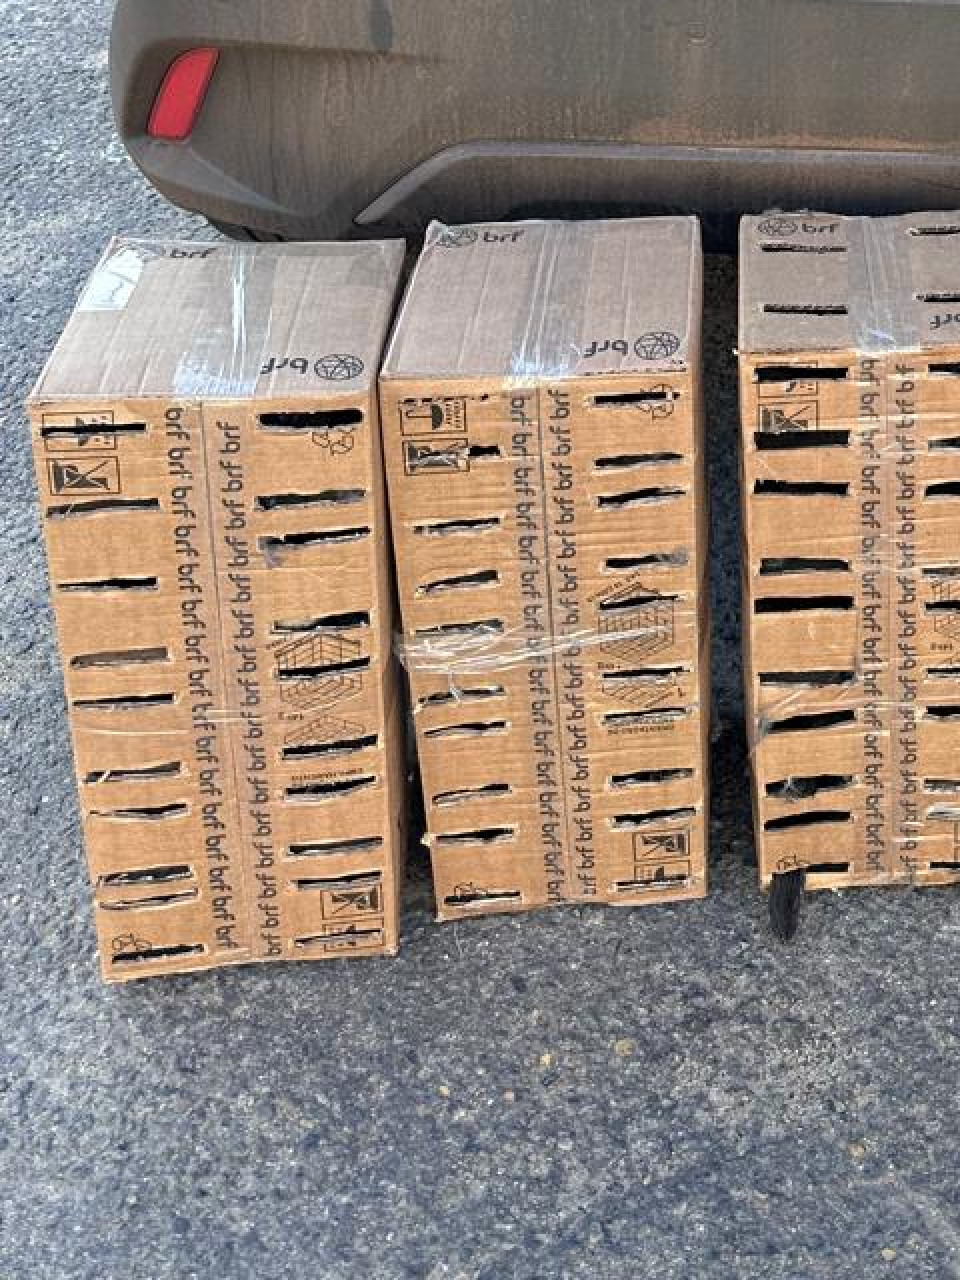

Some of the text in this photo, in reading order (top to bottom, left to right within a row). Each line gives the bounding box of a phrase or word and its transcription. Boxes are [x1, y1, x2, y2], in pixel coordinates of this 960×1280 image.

[583, 340, 629, 358] brf
[259, 357, 309, 375] brf
[548, 389, 570, 420] brf
[165, 408, 190, 440] brf
[550, 426, 571, 457] brf
[896, 436, 915, 464] brf
[168, 448, 192, 479] brf
[552, 462, 573, 491] brf
[514, 467, 536, 496] brf
[862, 465, 881, 494] brf
[896, 471, 915, 500] brf
[171, 486, 196, 518] brf
[553, 498, 575, 524] brf
[862, 500, 881, 528] brf
[516, 502, 537, 530] brf
[896, 506, 916, 534] brf
[174, 526, 199, 556] brf
[518, 536, 540, 564] brf
[178, 564, 202, 592] brf
[522, 570, 542, 598] brf
[557, 564, 578, 593] brf
[862, 570, 882, 598] brf
[897, 576, 917, 604] brf
[181, 600, 206, 628] brf
[524, 606, 544, 630] brf
[560, 598, 579, 625] brf
[863, 605, 882, 632] brf
[898, 610, 917, 638] brf
[185, 636, 210, 662] brf
[864, 638, 882, 662] brf
[898, 643, 917, 670] brf
[188, 670, 212, 696] brf
[529, 670, 550, 694] brf
[563, 660, 583, 689] brf
[864, 670, 882, 696] brf
[216, 422, 281, 956] brf brf brf brf brf brf brf brf brf brf brf brf brf brf brf brf
[532, 700, 553, 726] brf
[565, 693, 585, 720] brf
[196, 736, 219, 762] brf
[534, 732, 555, 756] brf
[566, 725, 587, 751] brf
[900, 738, 918, 764] brf
[537, 762, 557, 786] brf
[570, 756, 590, 781] brf
[865, 764, 884, 788] brf
[200, 770, 222, 796] brf
[900, 770, 918, 794] brf
[540, 792, 560, 817] brf
[572, 786, 591, 812] brf
[866, 794, 885, 818] brf
[202, 802, 226, 828] brf
[542, 824, 562, 848] brf
[574, 818, 593, 841] brf
[866, 824, 885, 846] brf
[205, 834, 230, 860] brf
[576, 846, 595, 869] brf
[544, 852, 565, 875] brf
[866, 850, 885, 872] brf
[209, 866, 232, 891] brf
[547, 880, 567, 901] brf
[212, 896, 236, 921] brf
[216, 925, 238, 948] brf
